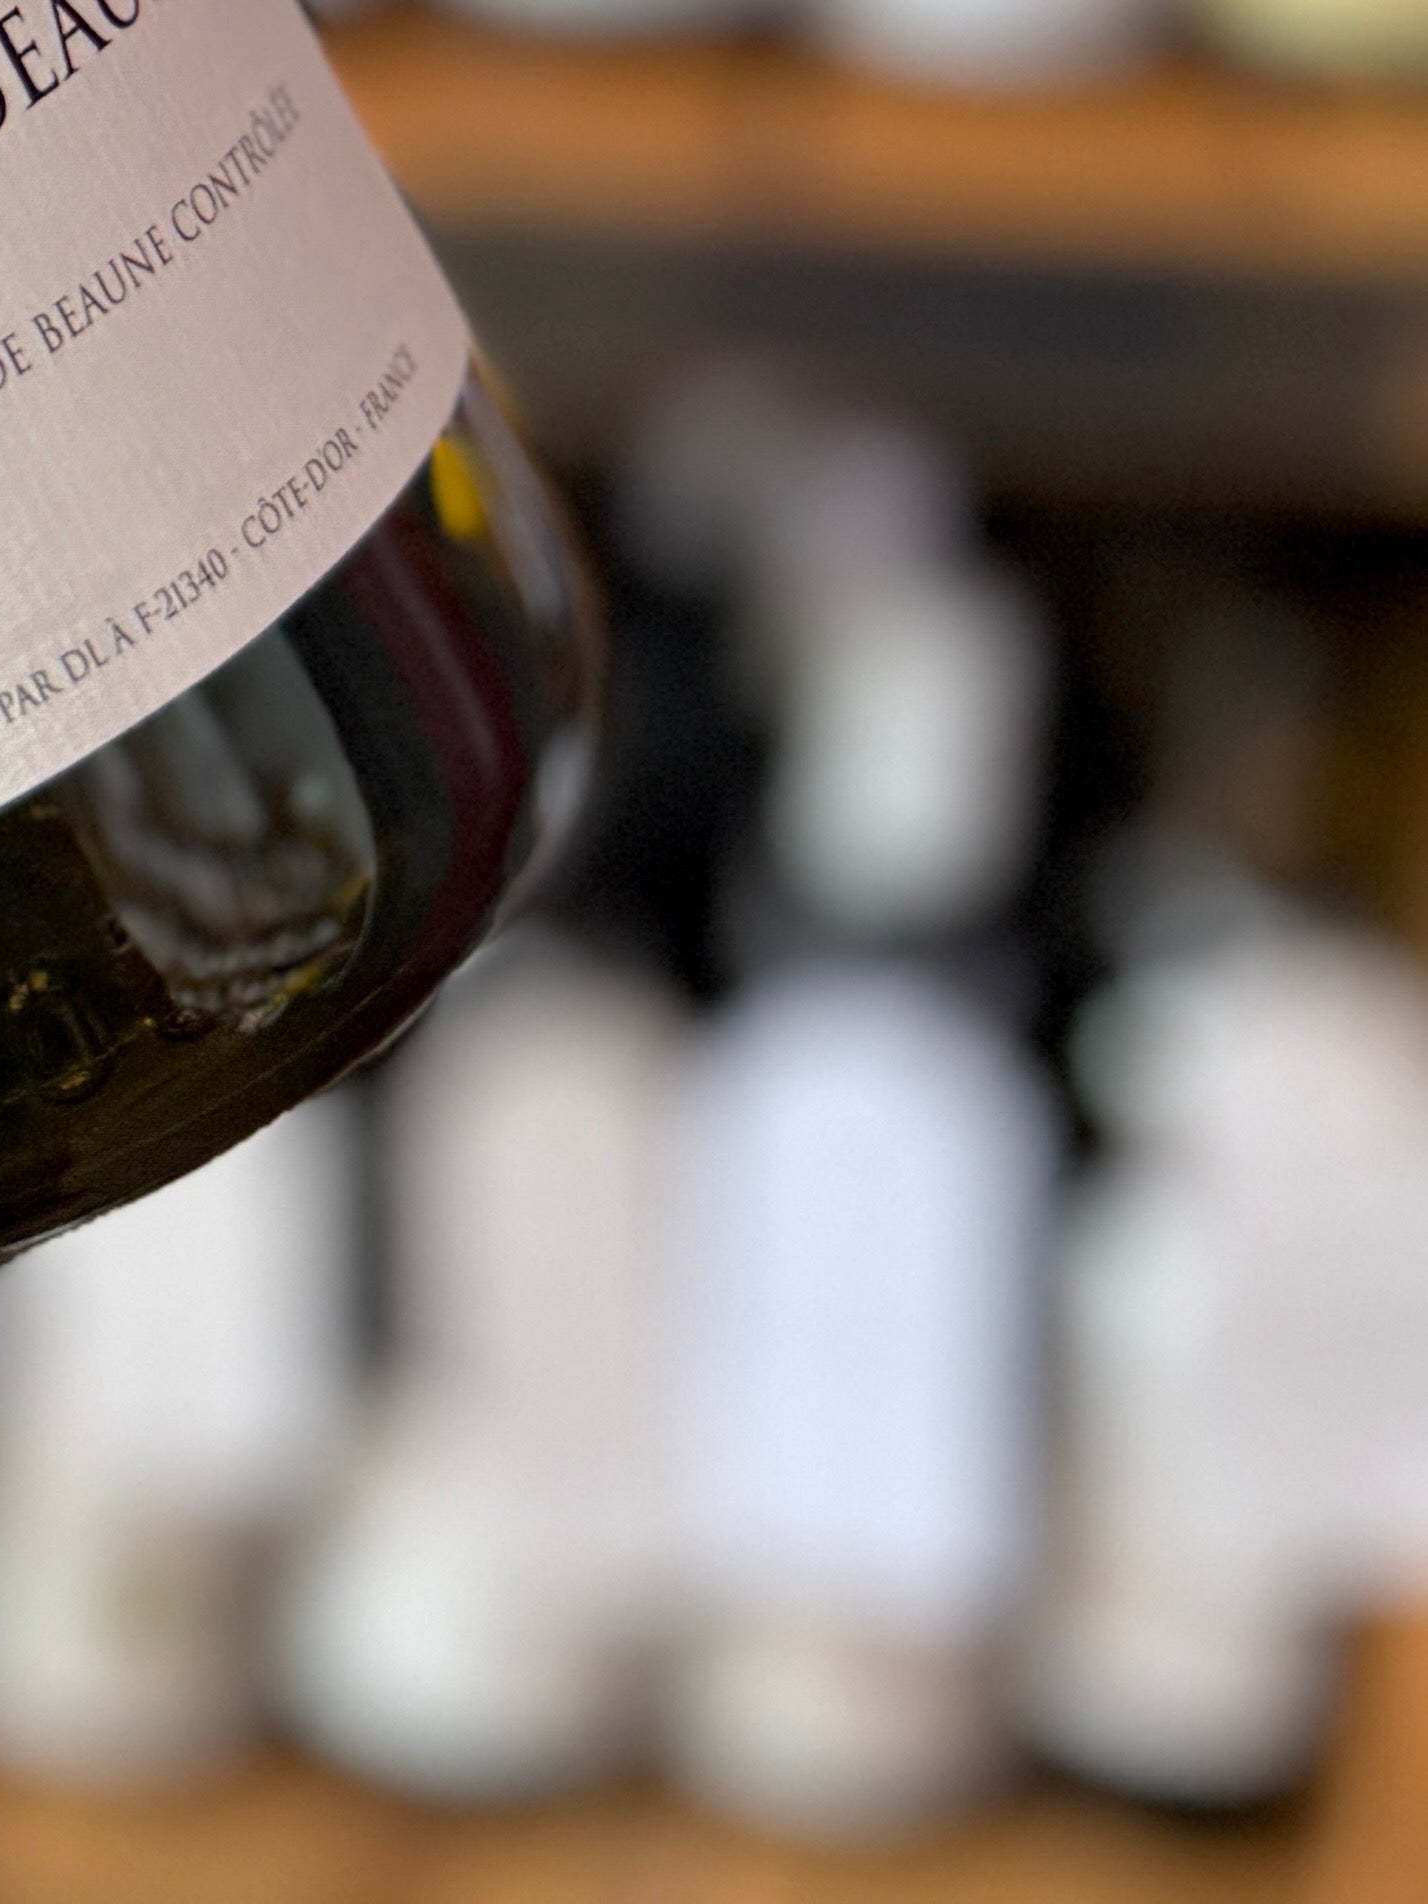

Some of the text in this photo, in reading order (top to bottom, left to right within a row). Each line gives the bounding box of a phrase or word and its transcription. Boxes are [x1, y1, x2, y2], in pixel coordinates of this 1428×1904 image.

[31, 224, 175, 355] BEAUNE
[59, 637, 110, 686] DL
[105, 616, 136, 656] À
[132, 547, 229, 636] F-21340
